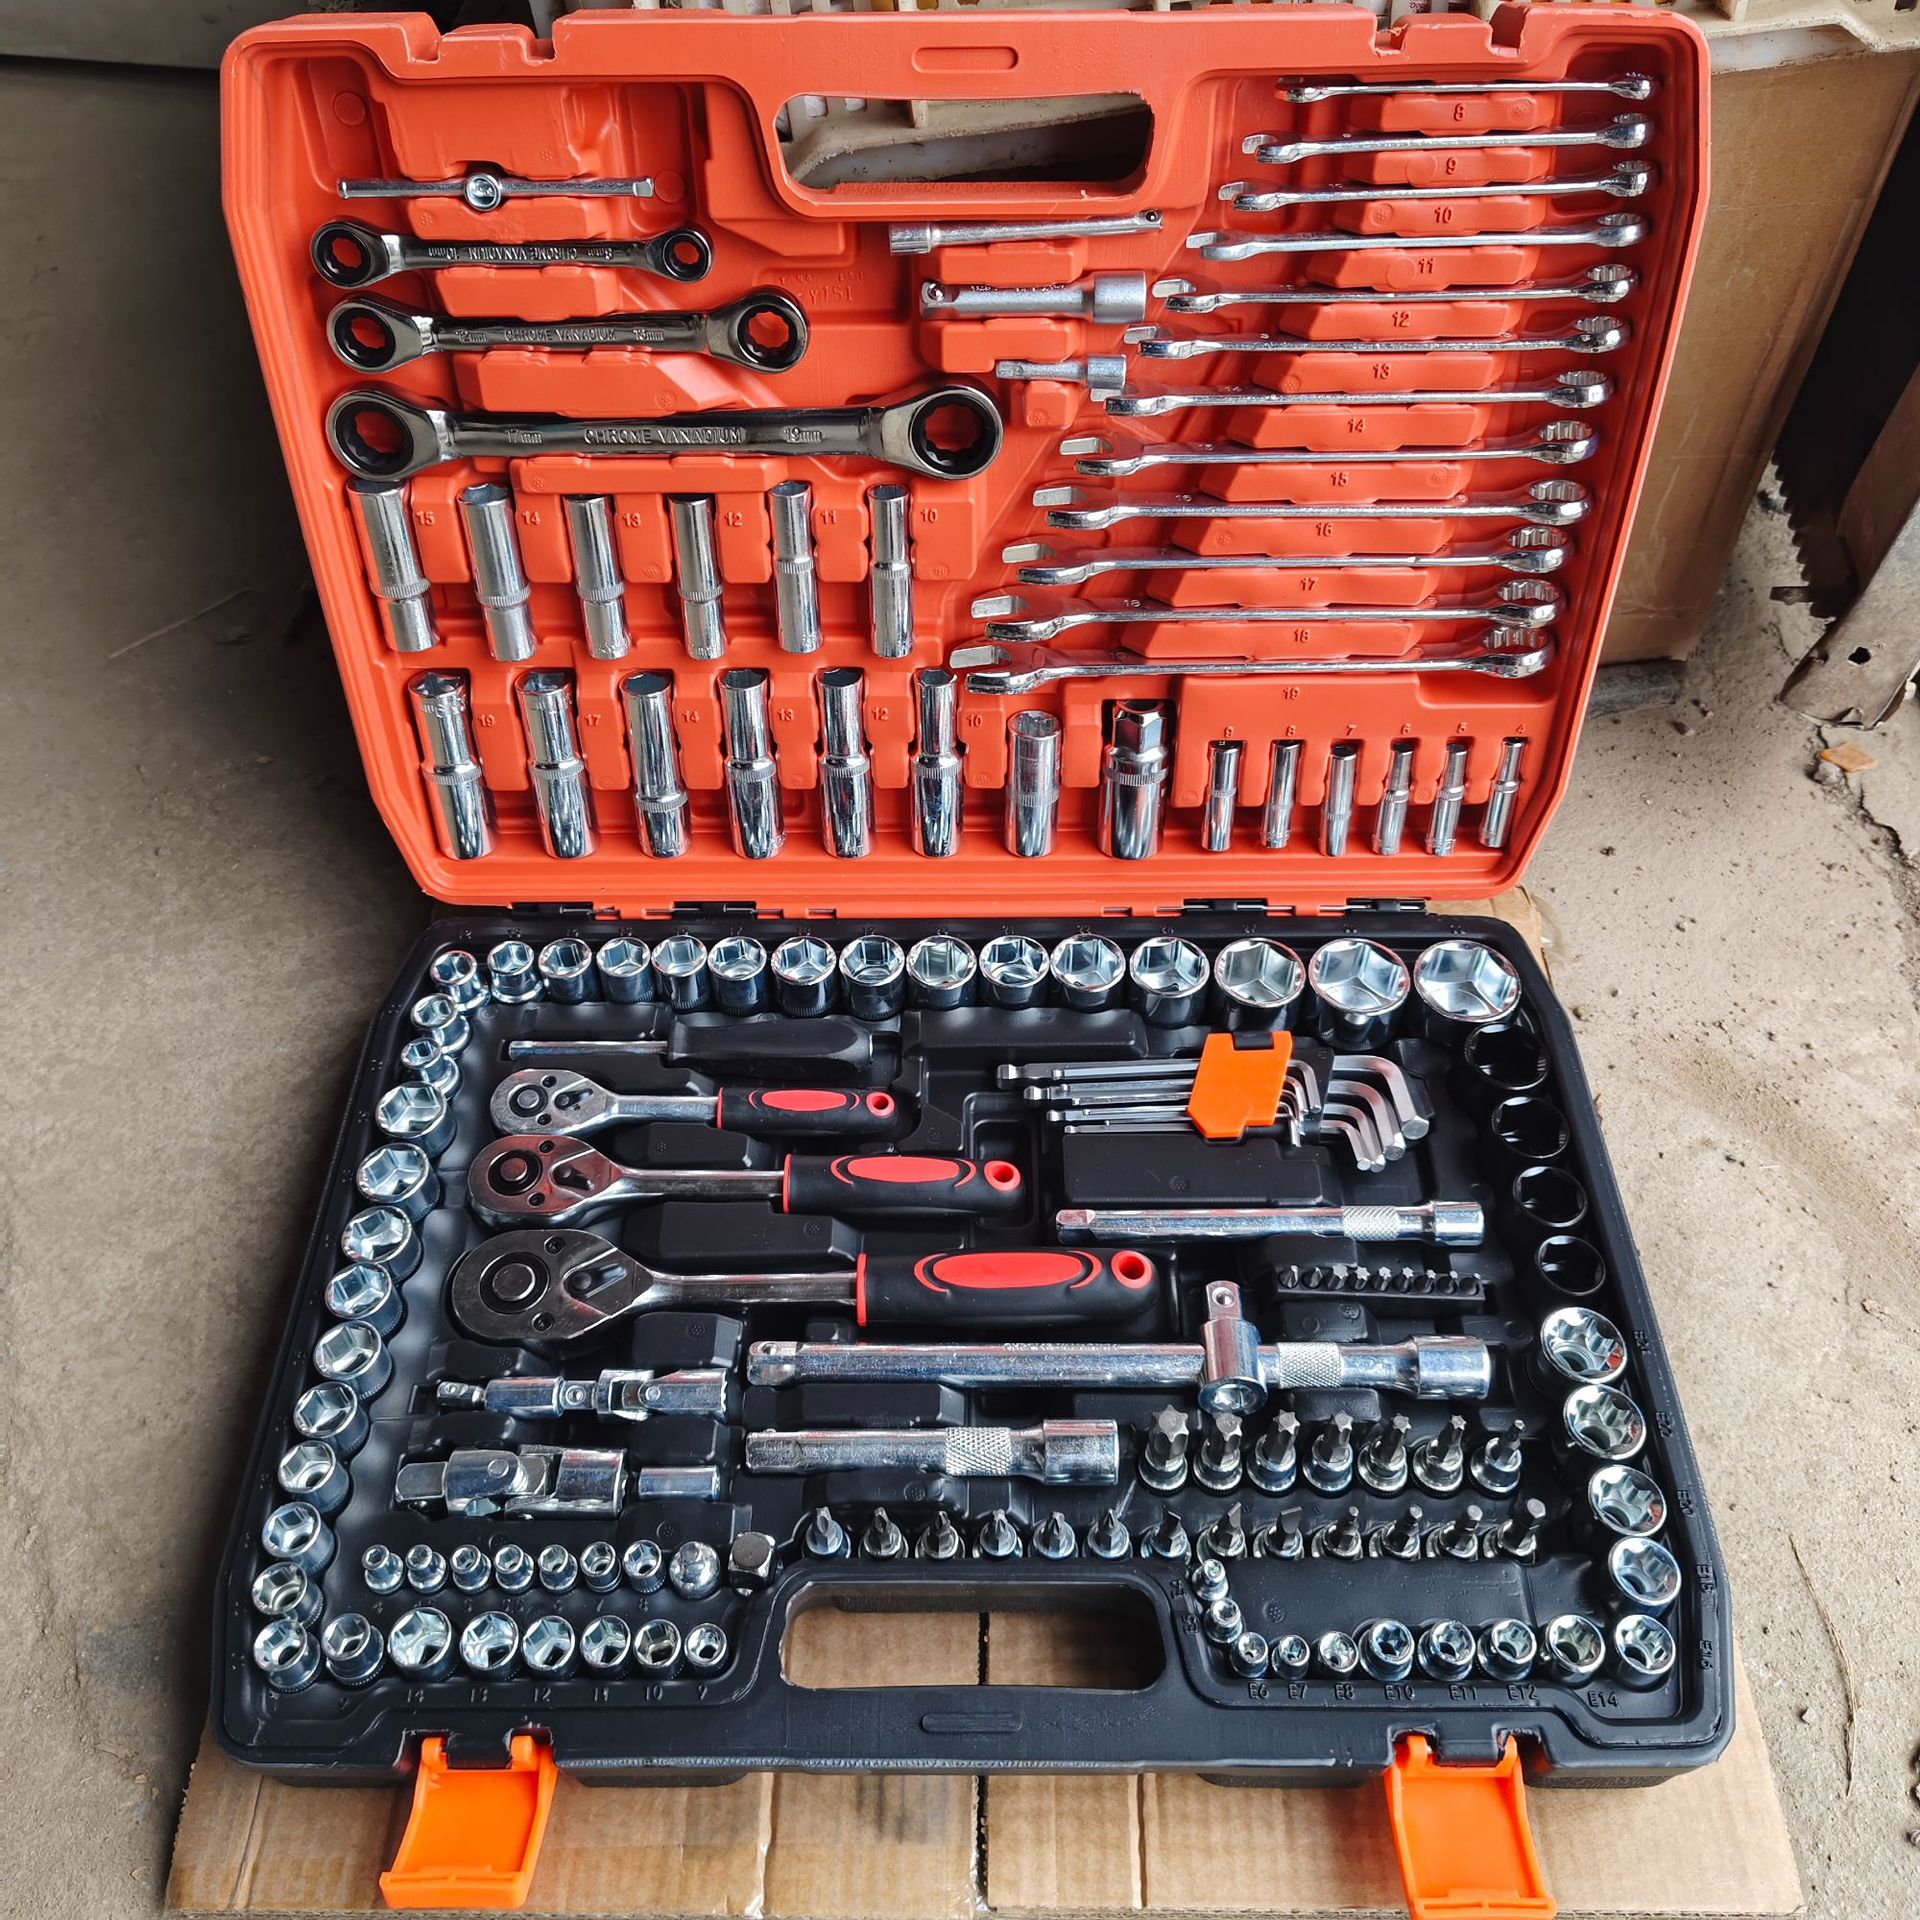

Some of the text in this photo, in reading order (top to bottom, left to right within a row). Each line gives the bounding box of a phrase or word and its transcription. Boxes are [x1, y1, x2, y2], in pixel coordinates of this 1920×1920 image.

[1453, 104, 1464, 120] 8
[1445, 157, 1456, 174] 9
[1433, 206, 1452, 223] 10
[1418, 257, 1434, 274] 11
[1391, 311, 1409, 327] 12
[504, 329, 553, 342] CHROME
[556, 328, 616, 341] VANADIUM
[1372, 363, 1389, 379] 13
[1347, 418, 1366, 434] 14
[505, 427, 822, 444] 17mm CHROME VANADIUM 19mm
[1330, 472, 1348, 488] 15
[416, 510, 435, 526] 15
[522, 510, 541, 525] 14
[623, 512, 641, 527] 13
[724, 512, 743, 527] 12
[820, 510, 838, 525] 11
[921, 508, 938, 523] 10
[1315, 522, 1332, 537] 16
[1300, 577, 1318, 592] 17
[1293, 628, 1310, 643] 18
[1282, 686, 1298, 701] 19
[584, 713, 602, 726] 17
[682, 710, 700, 723] 14
[777, 708, 794, 721] 13
[871, 707, 889, 721] 12
[966, 714, 983, 727] 10
[1224, 725, 1234, 739] 9
[1346, 725, 1357, 737] 7
[1516, 723, 1526, 735] 4
[407, 1688, 425, 1703] 14
[534, 1687, 552, 1703] 12
[645, 1685, 663, 1702] 10
[1248, 1683, 1269, 1700] E6
[1288, 1683, 1309, 1700] E7
[1335, 1683, 1355, 1700] E8
[1385, 1684, 1415, 1700] E10
[1450, 1685, 1478, 1701] E11
[1507, 1685, 1539, 1702] E12
[1587, 1691, 1619, 1708] E14
